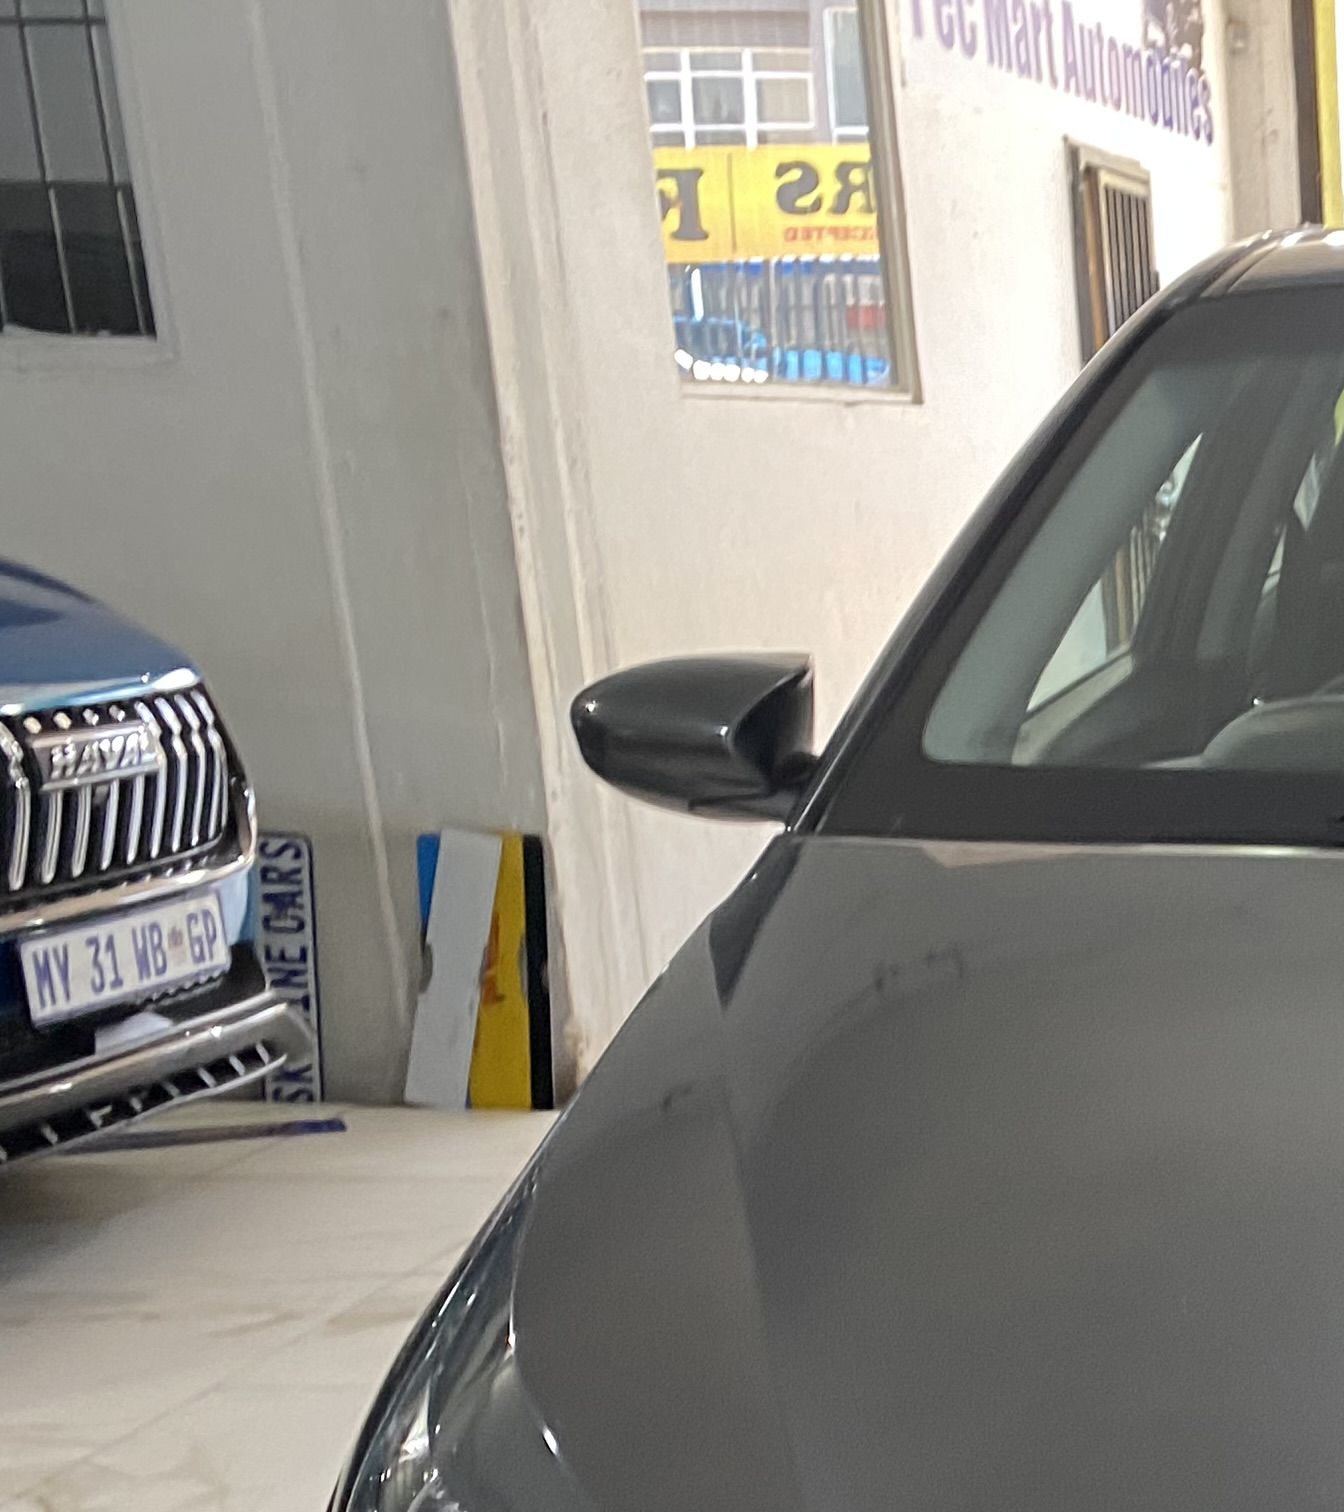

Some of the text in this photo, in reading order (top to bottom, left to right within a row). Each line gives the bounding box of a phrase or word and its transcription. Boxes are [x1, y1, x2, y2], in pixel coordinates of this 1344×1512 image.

[1061, 0, 1214, 146] Automobiles
[50, 726, 157, 780] HAVAL
[258, 839, 306, 934] CARS
[32, 908, 217, 1009] MY 31 WB GP
